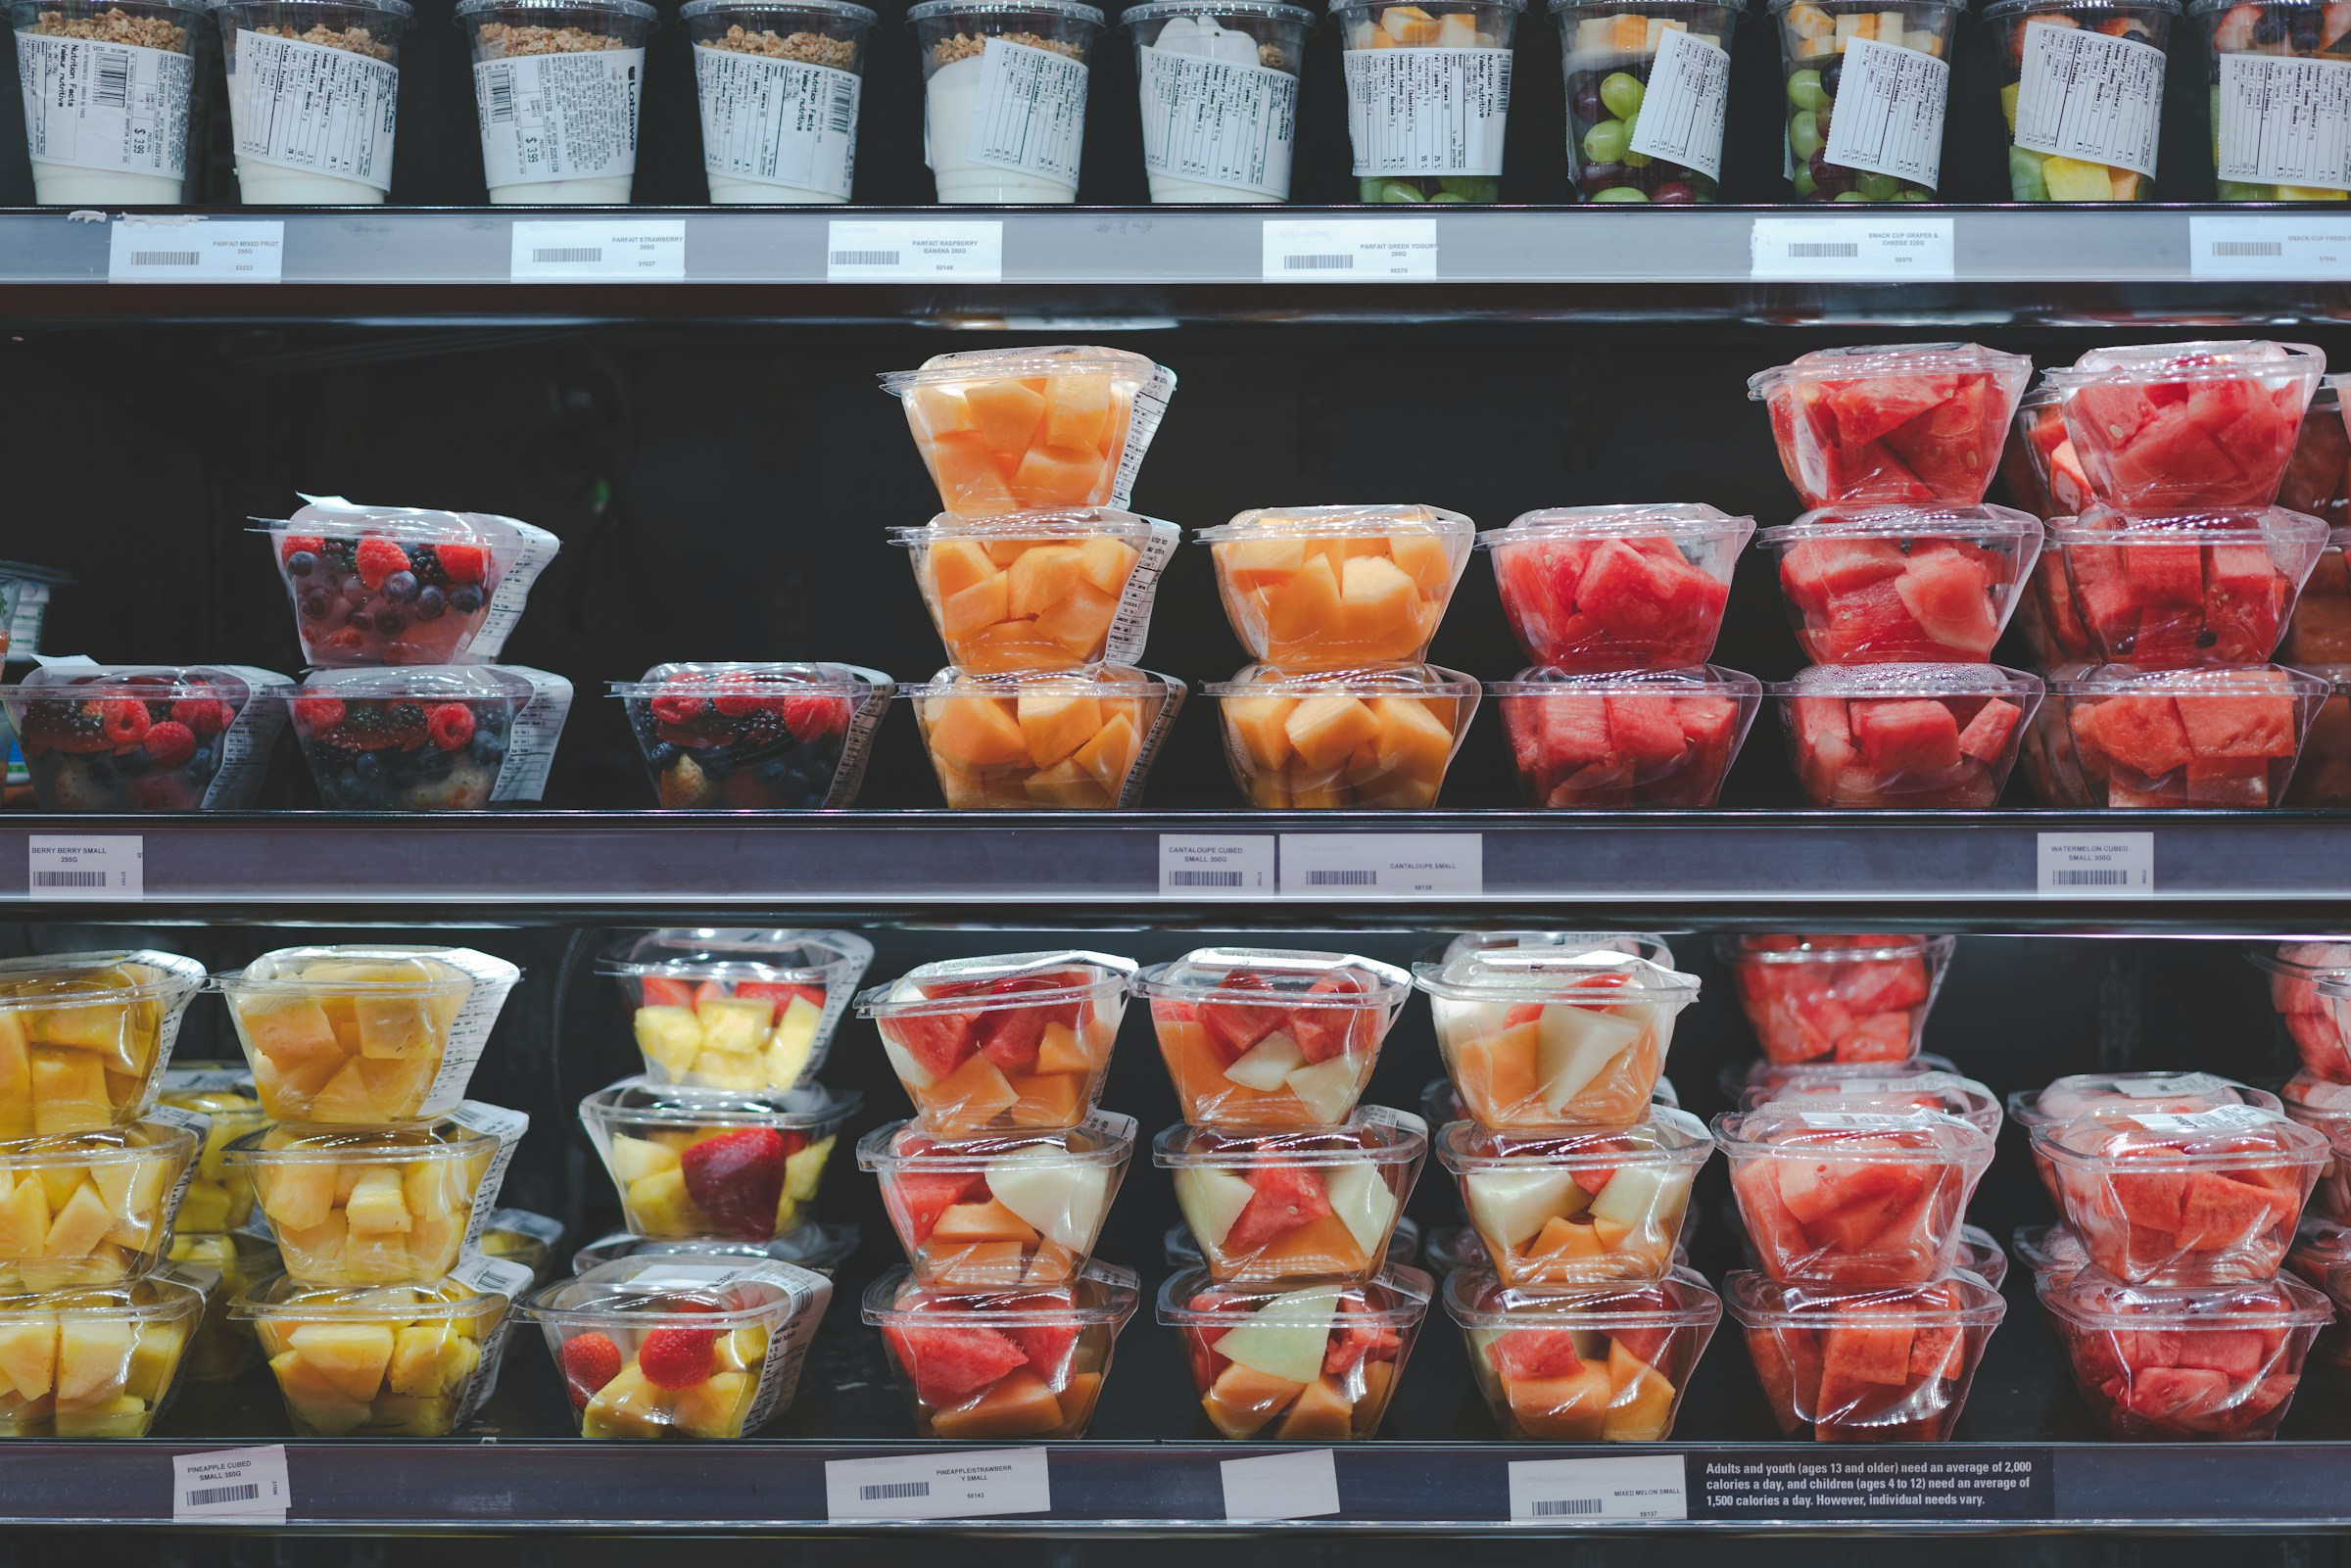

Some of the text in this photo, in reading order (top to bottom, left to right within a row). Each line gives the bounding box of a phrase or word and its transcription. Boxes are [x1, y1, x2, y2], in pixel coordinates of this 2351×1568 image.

[60, 44, 68, 68] Valeur
[68, 45, 78, 107] Nutrition Facts
[797, 70, 810, 131] Valeur nutritive
[807, 71, 820, 132] Nutrition Facts
[134, 139, 144, 154] 3.99
[527, 148, 538, 162] 3.99
[188, 1460, 251, 1473] PINEAPPLE CUBED
[936, 1465, 1012, 1475] PINEAPPLE/STRAWBERR
[1706, 1463, 1741, 1473] Adults
[1744, 1463, 1763, 1473] and
[1766, 1463, 1795, 1476] youth
[1798, 1463, 1827, 1476] (ages
[1831, 1463, 1842, 1473] 13
[1845, 1462, 1864, 1473] and
[1867, 1462, 1898, 1474] older)
[1901, 1462, 1927, 1473] need
[1946, 1464, 1989, 1475] average
[1992, 1461, 2002, 1472] of
[2005, 1462, 2031, 1474] 2,000
[199, 1472, 223, 1481] SMALL
[1707, 1479, 1750, 1489] calories
[1763, 1479, 1784, 1492] day,
[1787, 1478, 1806, 1489] and
[1810, 1478, 1853, 1489] children
[1857, 1478, 1886, 1491] (ages
[1888, 1479, 1895, 1489] 4
[1896, 1479, 1907, 1489] to
[1911, 1478, 1925, 1491] 12)
[1929, 1477, 1954, 1488] need
[1974, 1480, 2016, 1490] average
[2019, 1477, 2030, 1487] of
[1707, 1496, 1733, 1507] 1,500
[1736, 1495, 1779, 1505] calories
[1792, 1495, 1813, 1508] day.
[1817, 1495, 1866, 1506] However,
[1870, 1494, 1921, 1505] individual
[1925, 1494, 1957, 1504] needs
[1960, 1496, 1984, 1506] vary.
